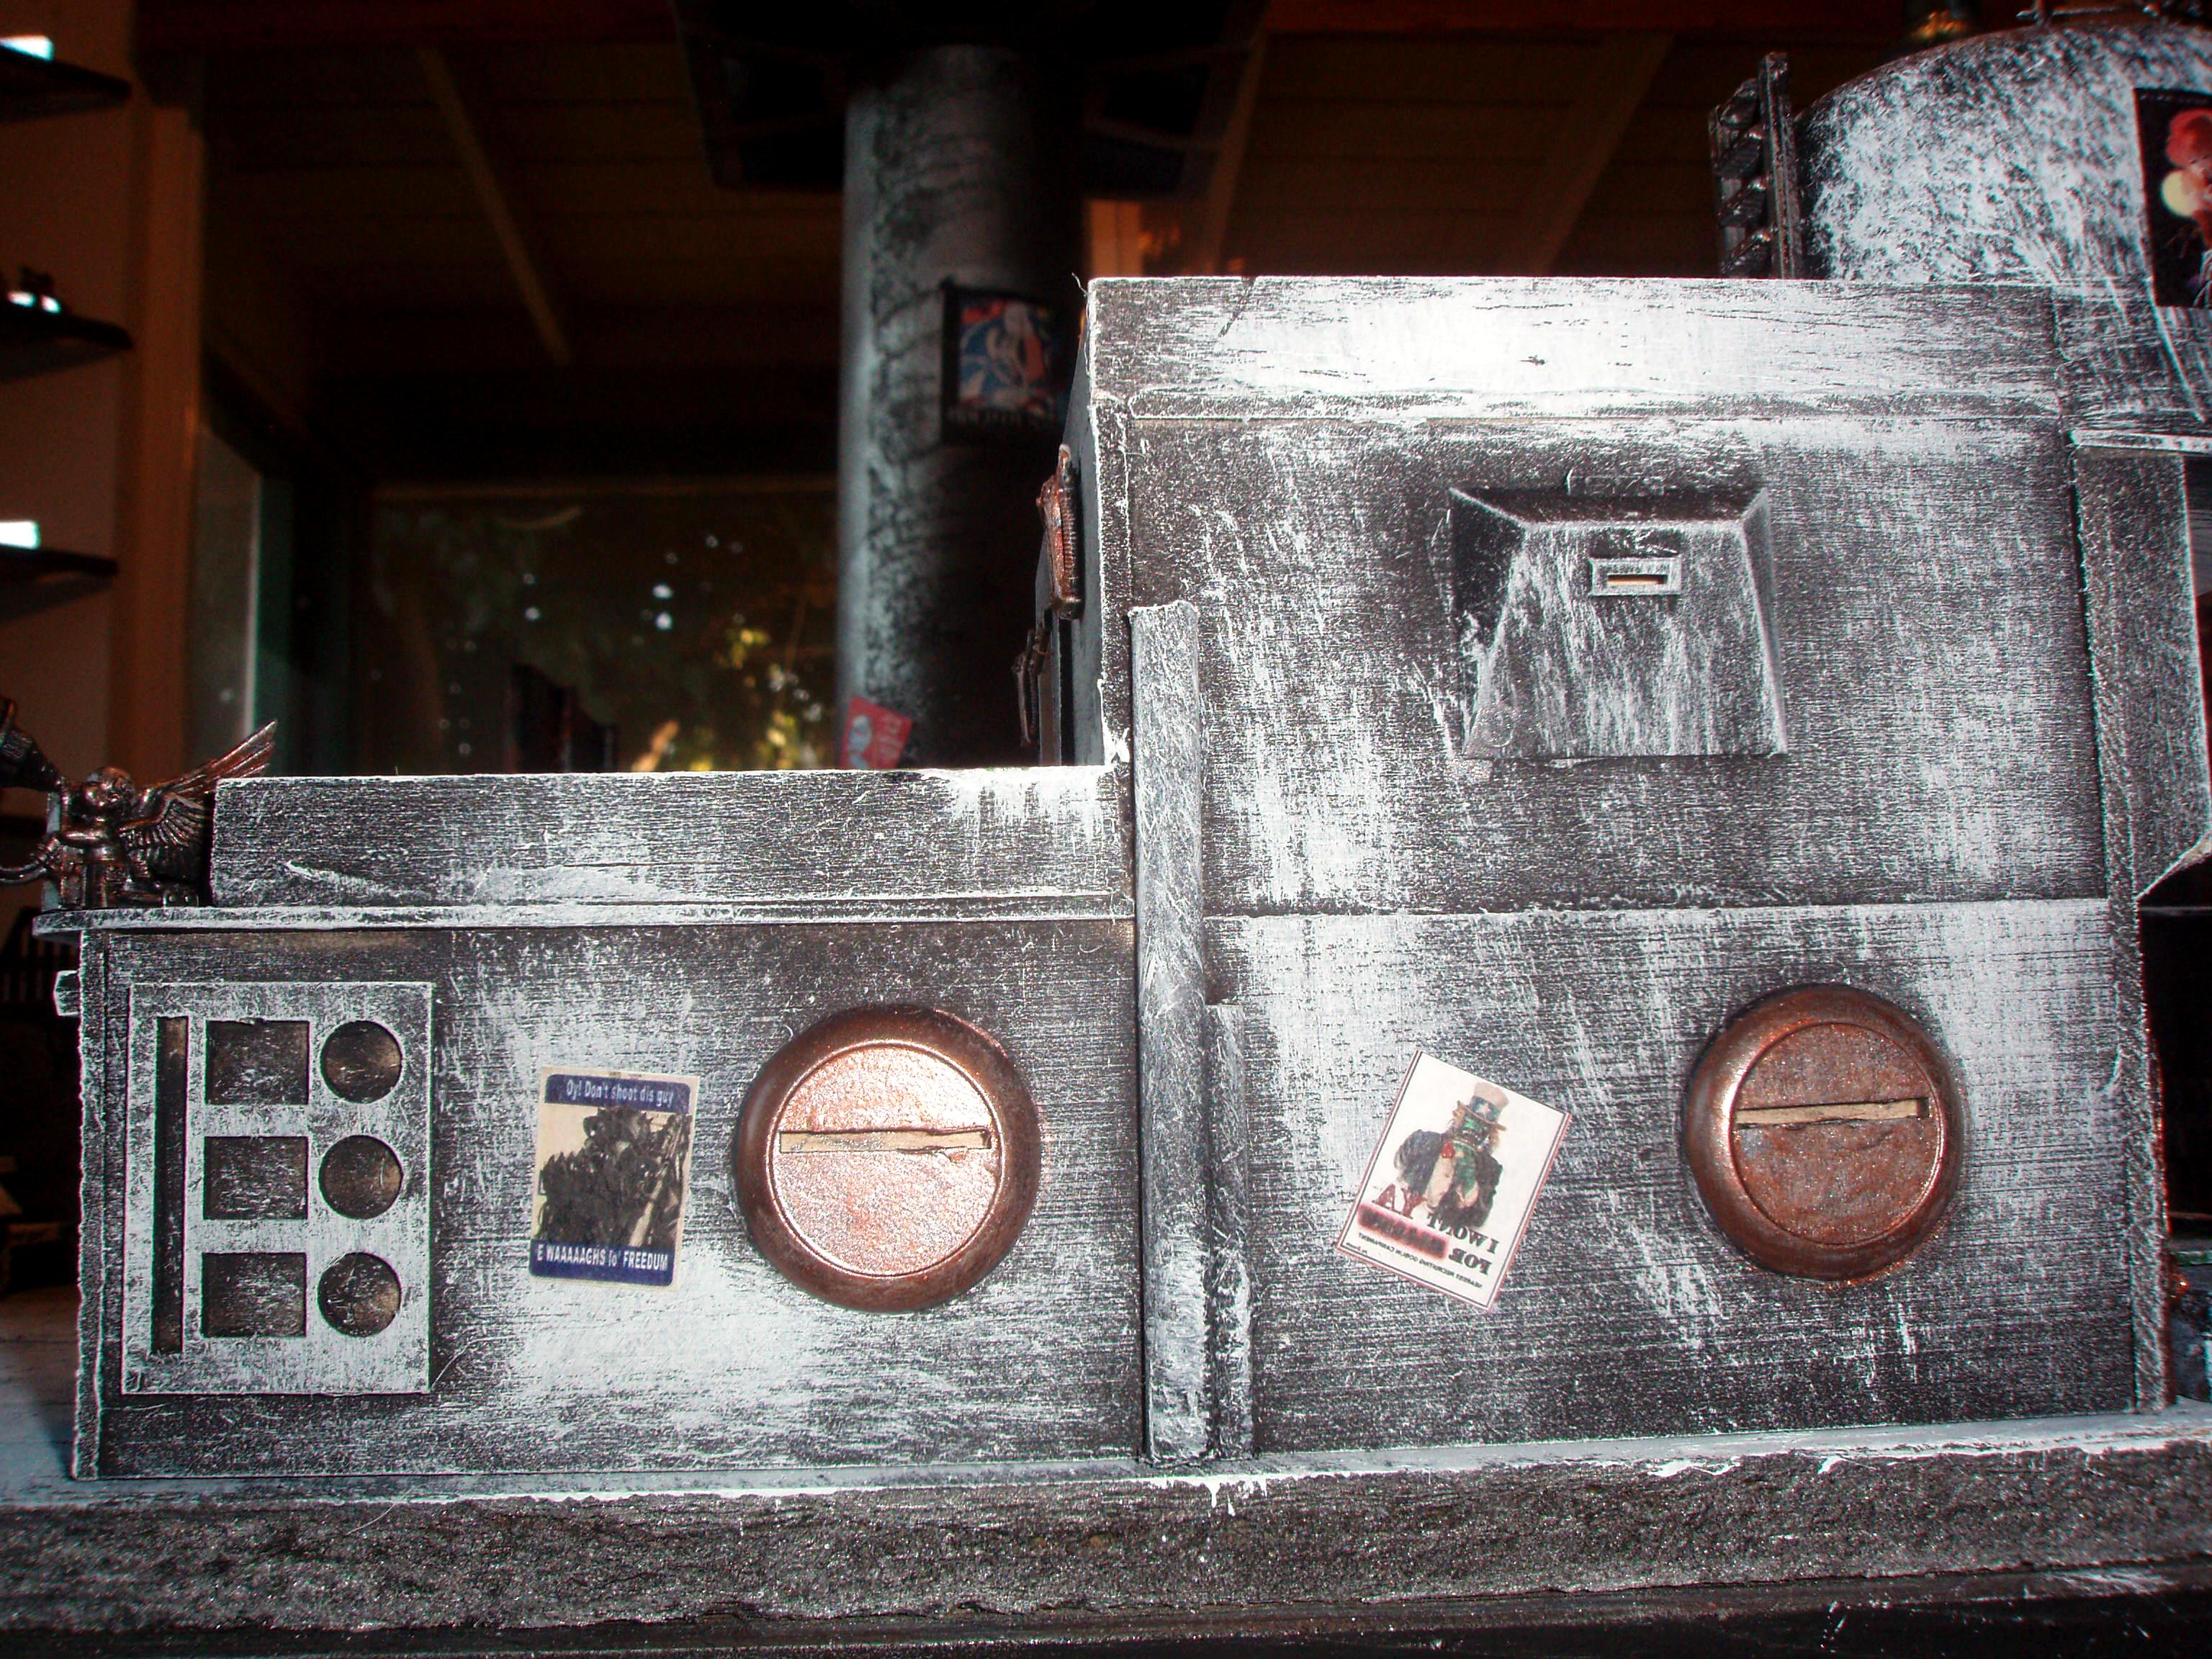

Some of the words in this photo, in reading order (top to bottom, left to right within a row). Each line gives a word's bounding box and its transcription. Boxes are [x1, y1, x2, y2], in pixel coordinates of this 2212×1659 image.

[585, 1080, 609, 1100] Don't
[611, 1083, 637, 1101] shoot
[639, 1086, 654, 1102] dis
[656, 1089, 674, 1108] guy
[623, 1251, 668, 1271] FREEDUM
